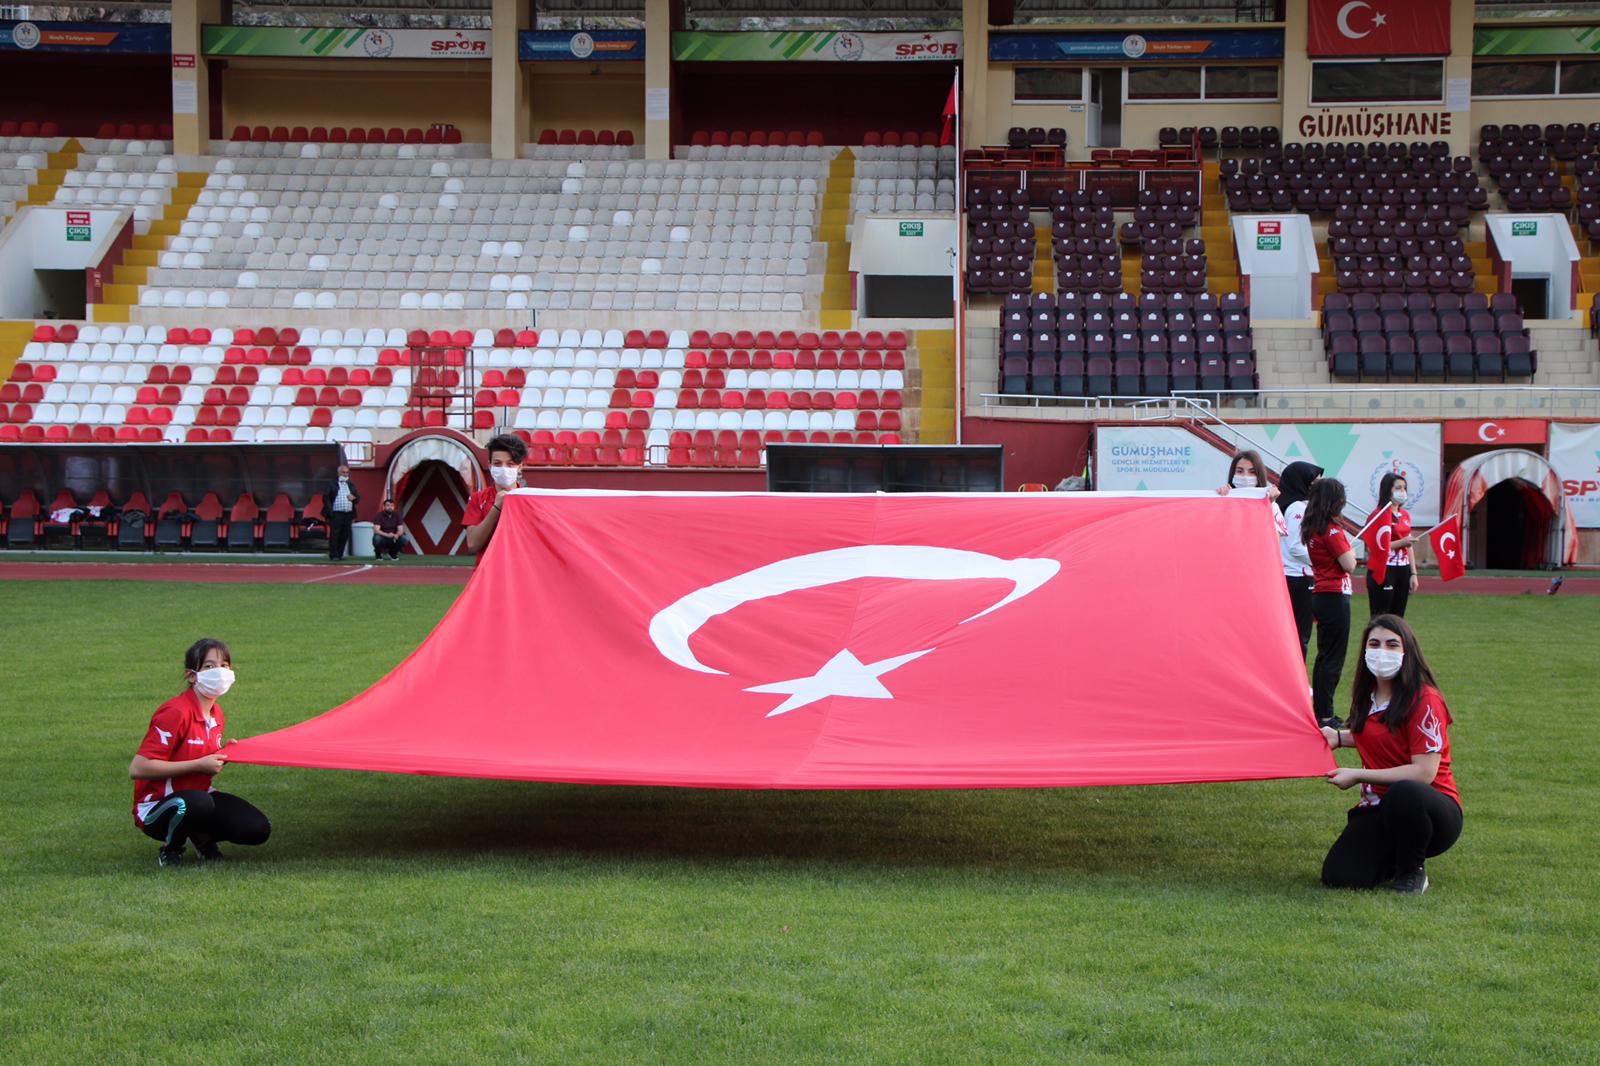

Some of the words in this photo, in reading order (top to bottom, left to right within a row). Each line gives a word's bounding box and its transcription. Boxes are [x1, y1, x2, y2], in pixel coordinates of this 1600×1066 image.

[430, 40, 486, 51] SPOR
[895, 43, 958, 55] SPOR
[1298, 107, 1452, 138] GÜMÜŞHANE
[901, 222, 922, 230] ÇIKIŞ
[1513, 222, 1535, 230] ÇIKIŞ
[68, 227, 89, 236] ÇIKIŞ
[1258, 237, 1280, 245] ÇIKIŞ
[1111, 444, 1191, 459] GÜMÜŞHANE
[1143, 465, 1185, 473] MÜDÜRLÜĞÜ
[1562, 480, 1600, 496] SP
